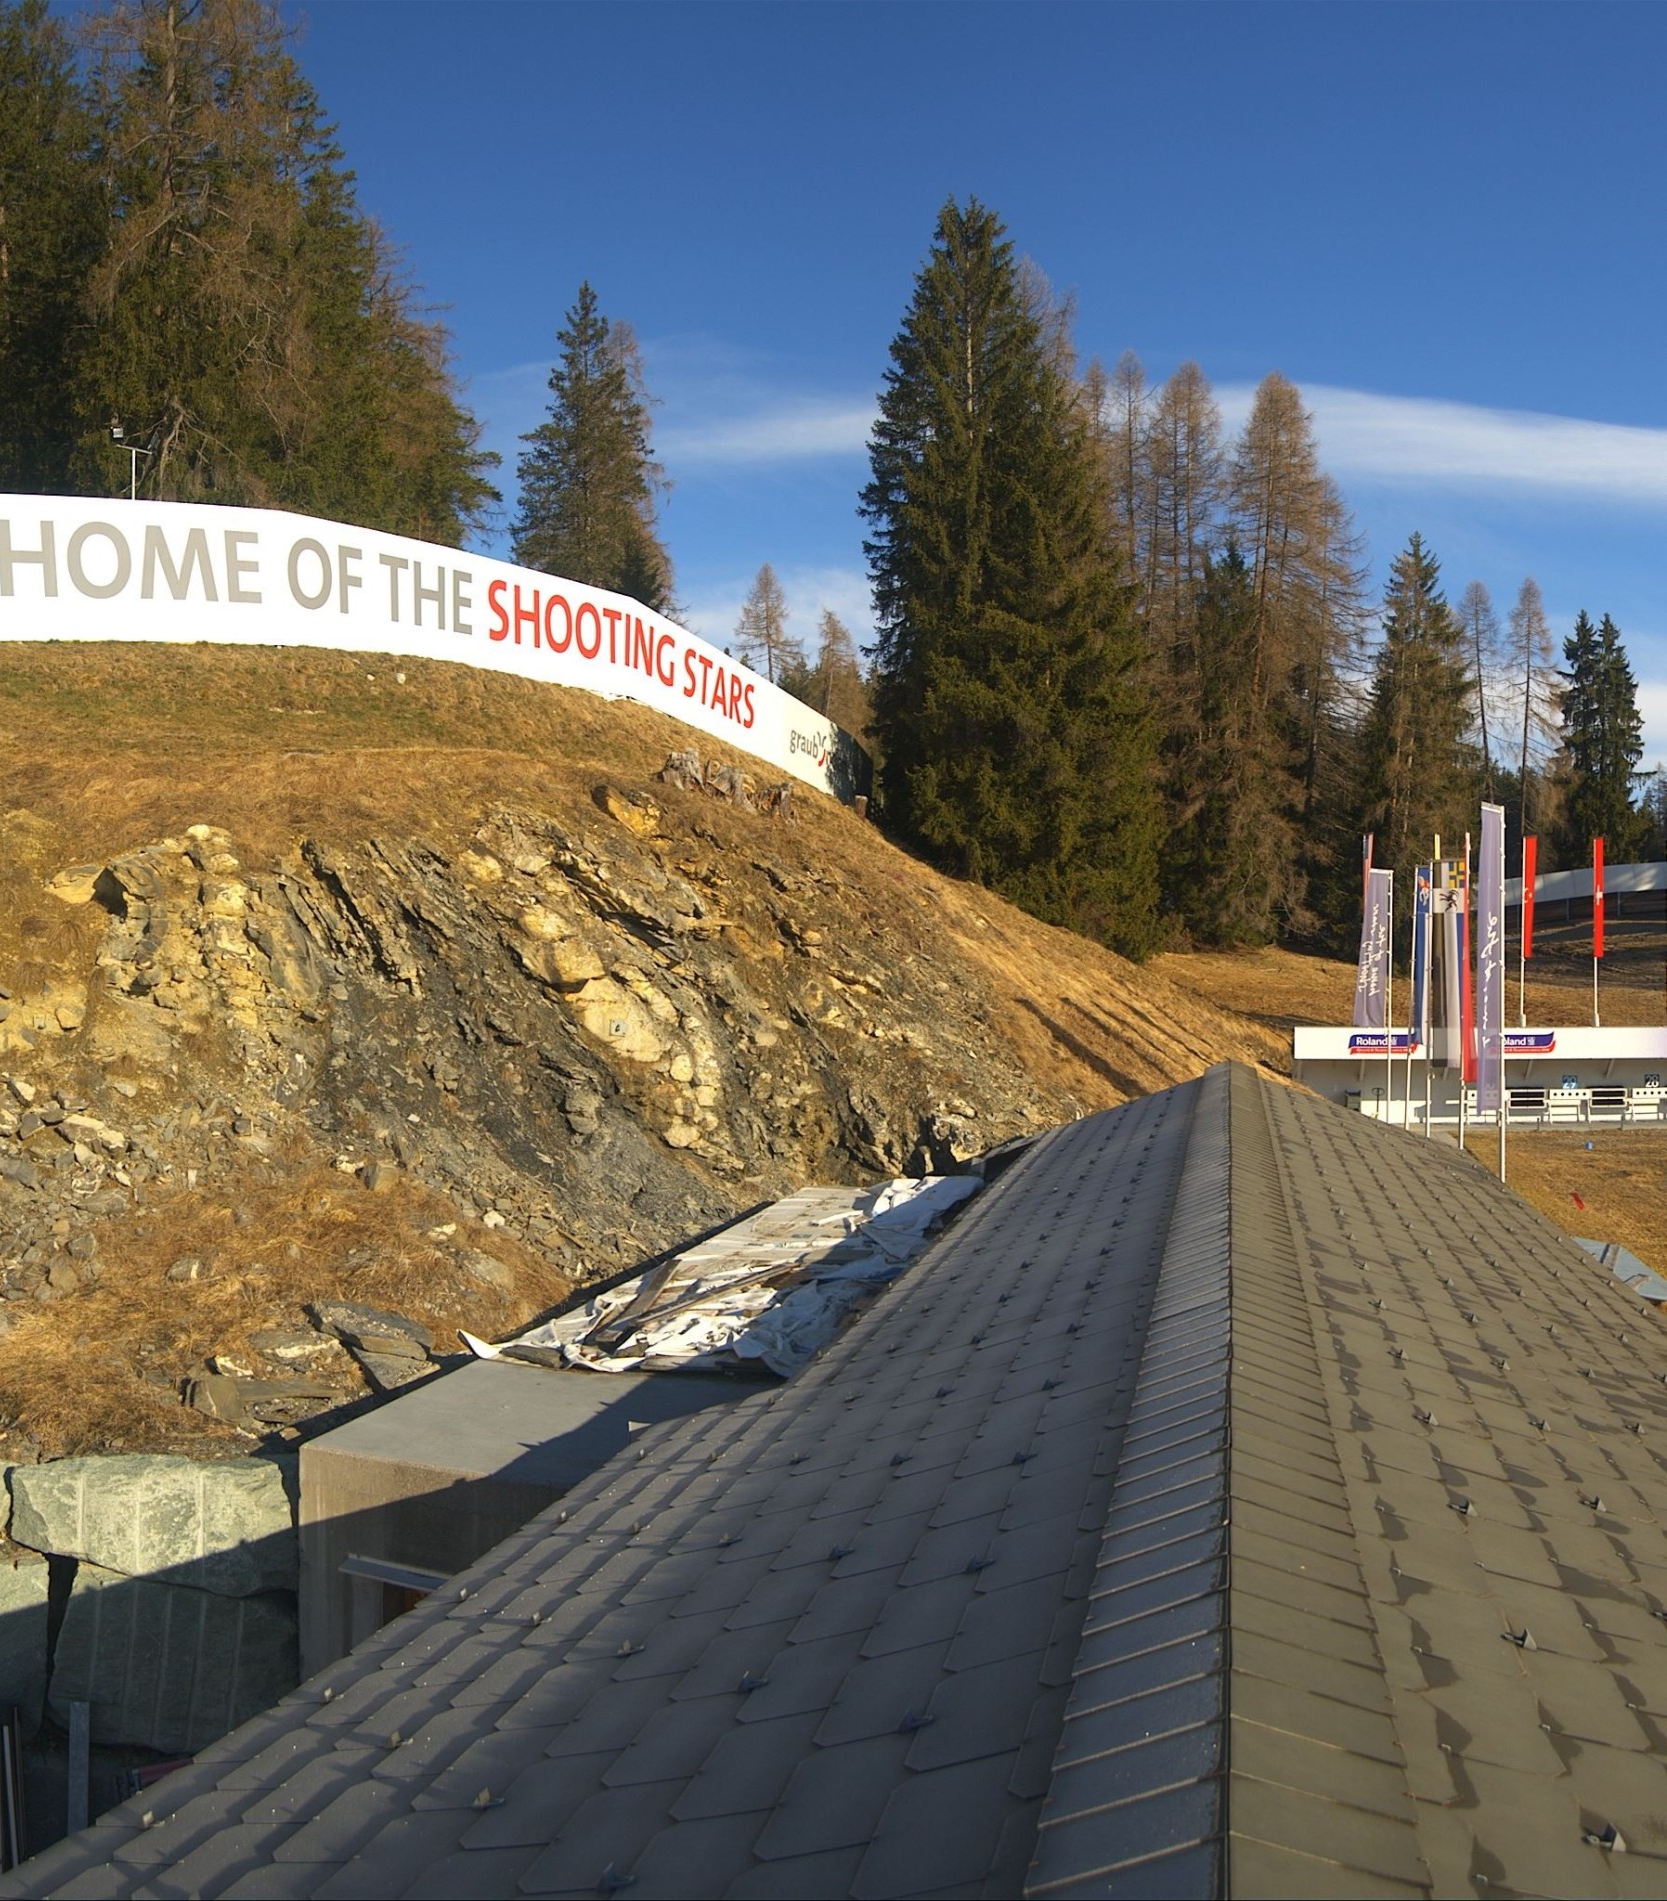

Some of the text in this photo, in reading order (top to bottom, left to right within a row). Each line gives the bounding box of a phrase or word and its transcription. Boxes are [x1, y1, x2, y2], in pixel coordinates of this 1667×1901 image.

[287, 537, 363, 614] OF
[379, 552, 473, 635] THE
[487, 579, 675, 687] SHOOTING
[683, 648, 755, 729] STARS
[1356, 1036, 1388, 1046] Roland
